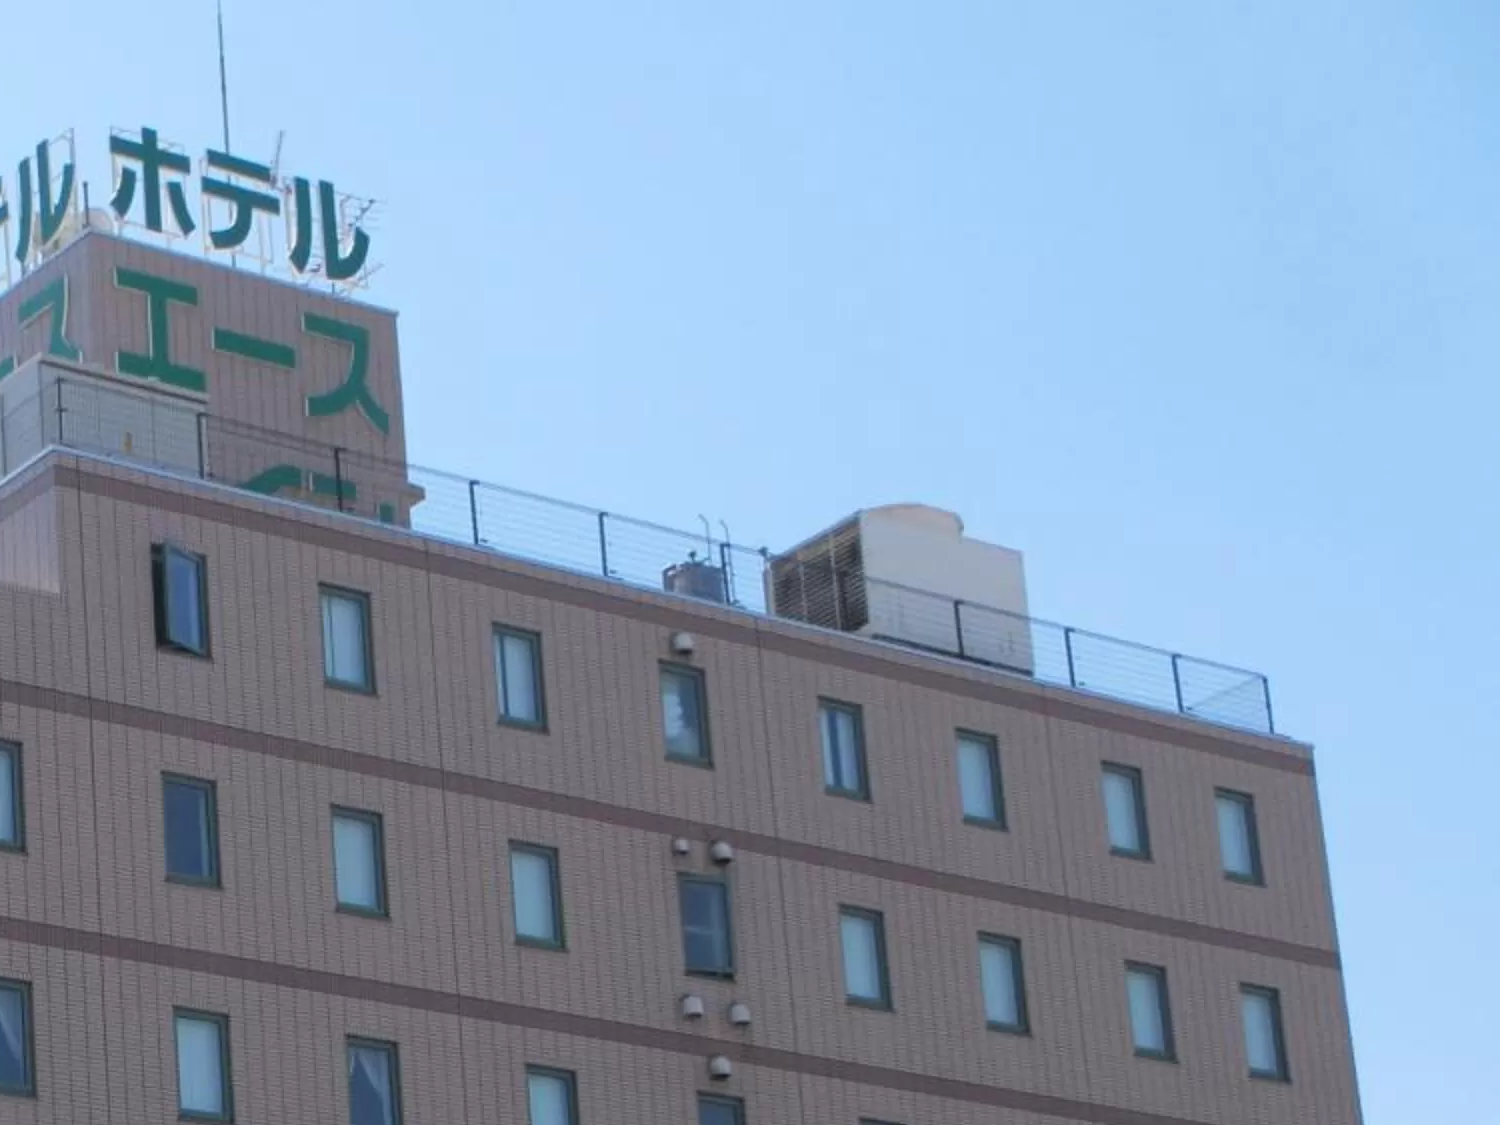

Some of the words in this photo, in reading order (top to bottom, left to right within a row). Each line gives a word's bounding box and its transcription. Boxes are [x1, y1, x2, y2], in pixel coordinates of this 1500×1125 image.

[109, 127, 369, 281] ホテル
[115, 266, 389, 435] エース
